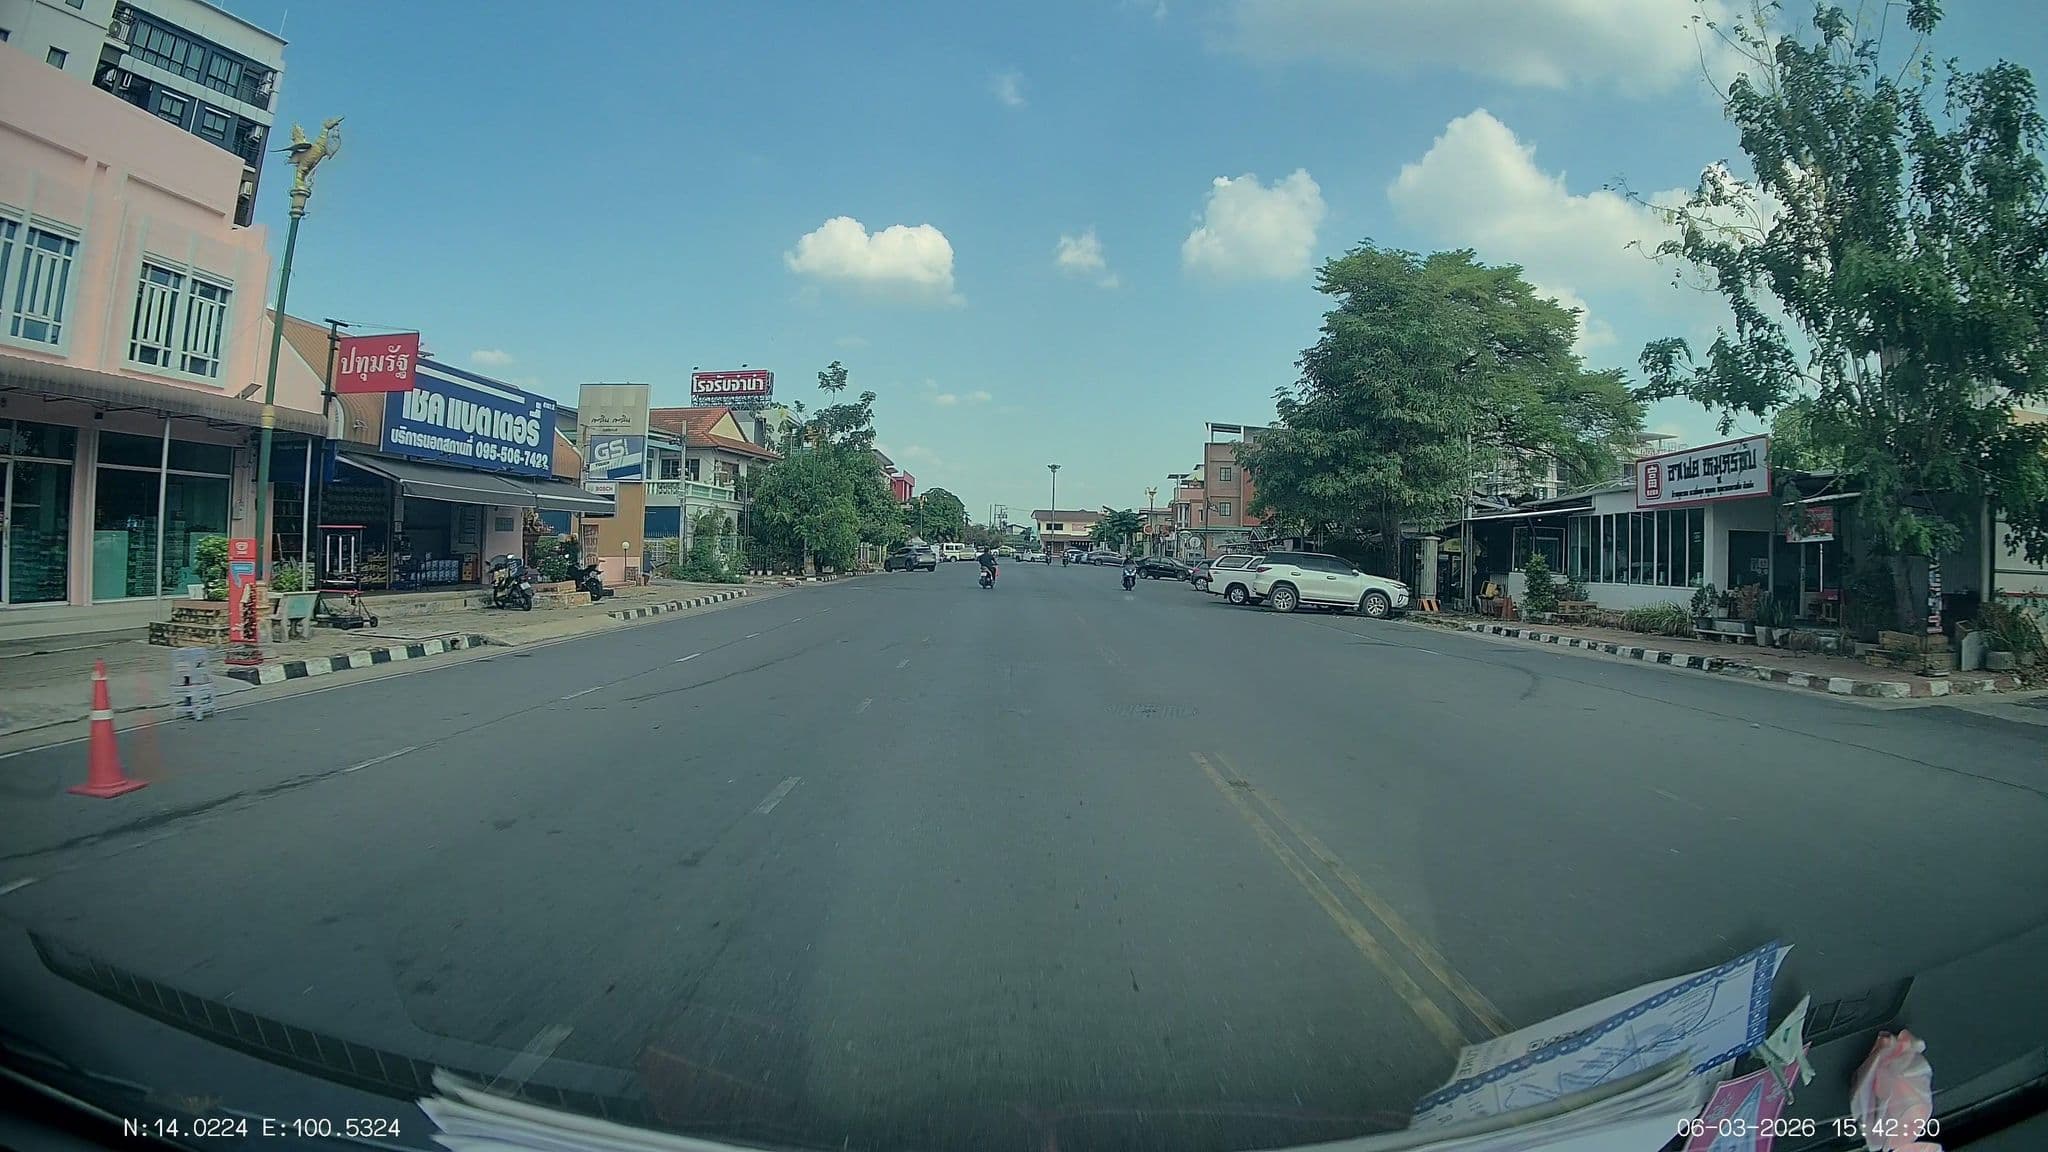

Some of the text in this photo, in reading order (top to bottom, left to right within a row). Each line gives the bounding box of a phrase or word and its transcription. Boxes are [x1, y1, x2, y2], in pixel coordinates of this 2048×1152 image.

[340, 344, 410, 381] ปทุมรัฐ
[475, 440, 549, 471] 095-506-7422
